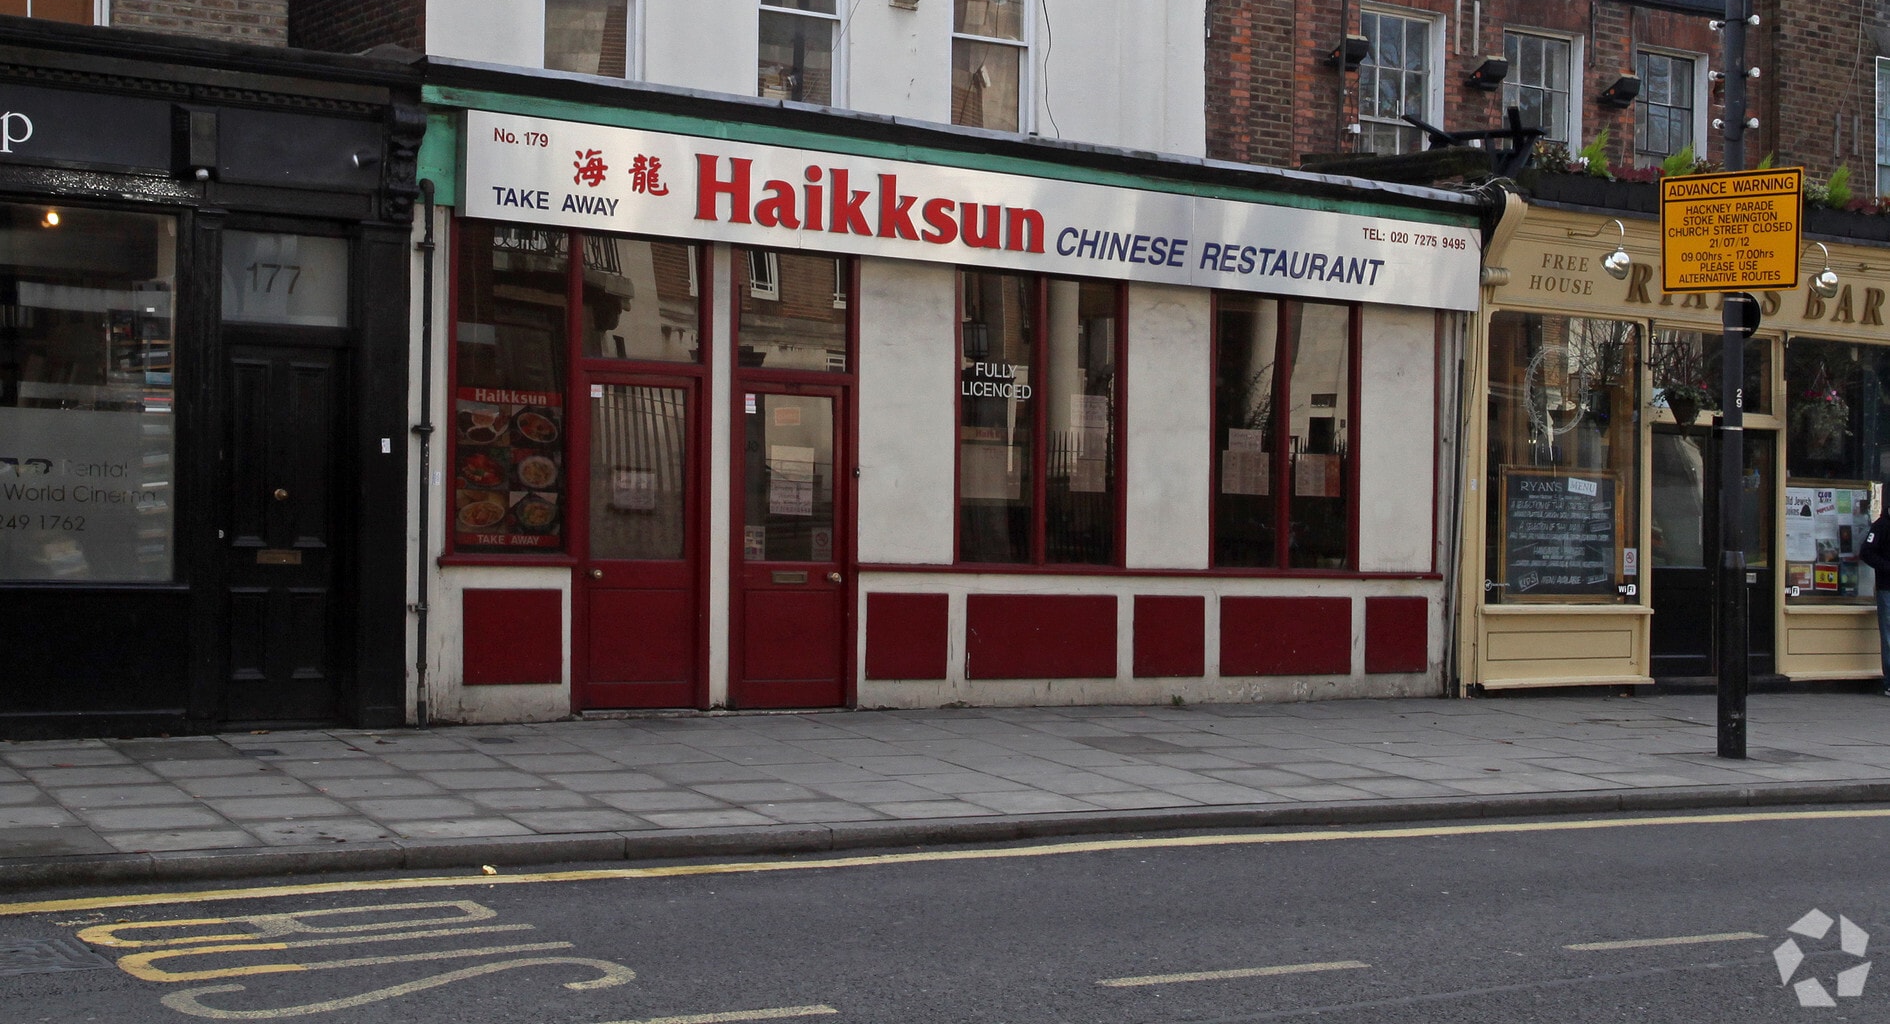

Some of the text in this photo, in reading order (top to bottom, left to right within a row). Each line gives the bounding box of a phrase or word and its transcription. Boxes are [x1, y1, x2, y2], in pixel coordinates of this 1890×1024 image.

[494, 128, 549, 147] No. 179
[1669, 176, 1794, 197] ADVANCE WARNING
[493, 186, 619, 216] TAKE AWAY
[694, 153, 1045, 253] Haikksun
[1686, 201, 1774, 215] HACKNEY PARADE
[1683, 212, 1778, 226] STOKE NEWINGTON
[1363, 227, 1466, 250] TEL: 020 7275 9495
[1668, 222, 1793, 237] CHURCH STREET CLOSED
[1709, 237, 1750, 248] 21/07/12
[1056, 227, 1384, 285] CHINESE RESTAURANT
[1541, 253, 1590, 272] FREE
[1681, 251, 1723, 262] 09.00hrs
[1736, 249, 1774, 260] 17.00hrs
[1700, 261, 1758, 272] PLEASE USE
[246, 262, 301, 294] 177
[1529, 274, 1594, 295] HOUSE
[1679, 270, 1781, 284] ALTERNATIVE ROUTES
[1803, 282, 1886, 326] BAR
[975, 362, 1017, 378] FULLY
[475, 389, 547, 405] Haikksun
[961, 381, 1032, 399] LICENCED
[4, 483, 156, 504] World Cinema
[1569, 479, 1596, 494] MENU
[0, 514, 85, 531] 49 1762
[478, 534, 539, 545] TAKE AWAY
[76, 900, 637, 1019] BUS
